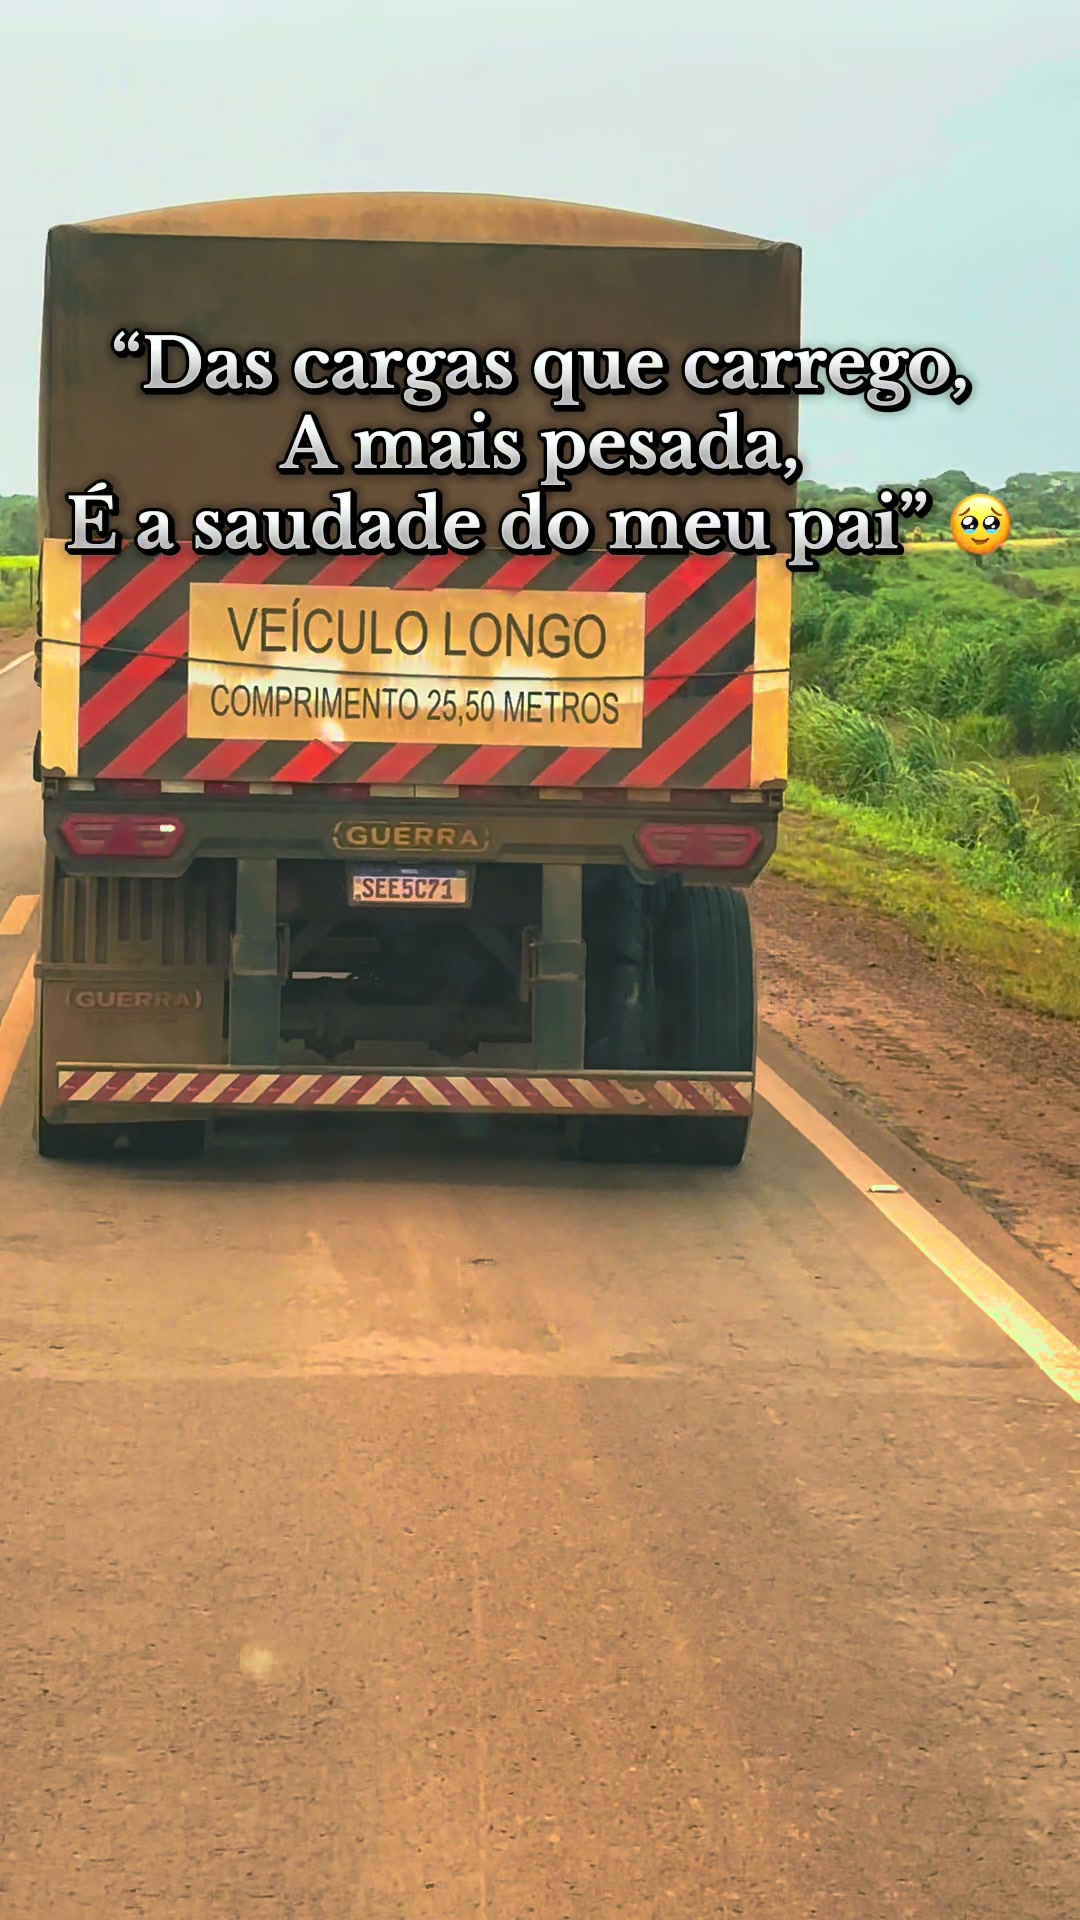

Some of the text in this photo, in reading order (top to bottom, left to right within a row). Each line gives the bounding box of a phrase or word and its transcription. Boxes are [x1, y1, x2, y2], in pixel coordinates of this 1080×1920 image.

[227, 598, 607, 659] VEÍCULO LONGO
[210, 684, 620, 725] COMPRIMENTO 25,50 METROS
[346, 825, 478, 846] GUERRA
[361, 877, 452, 900] SEE5C71
